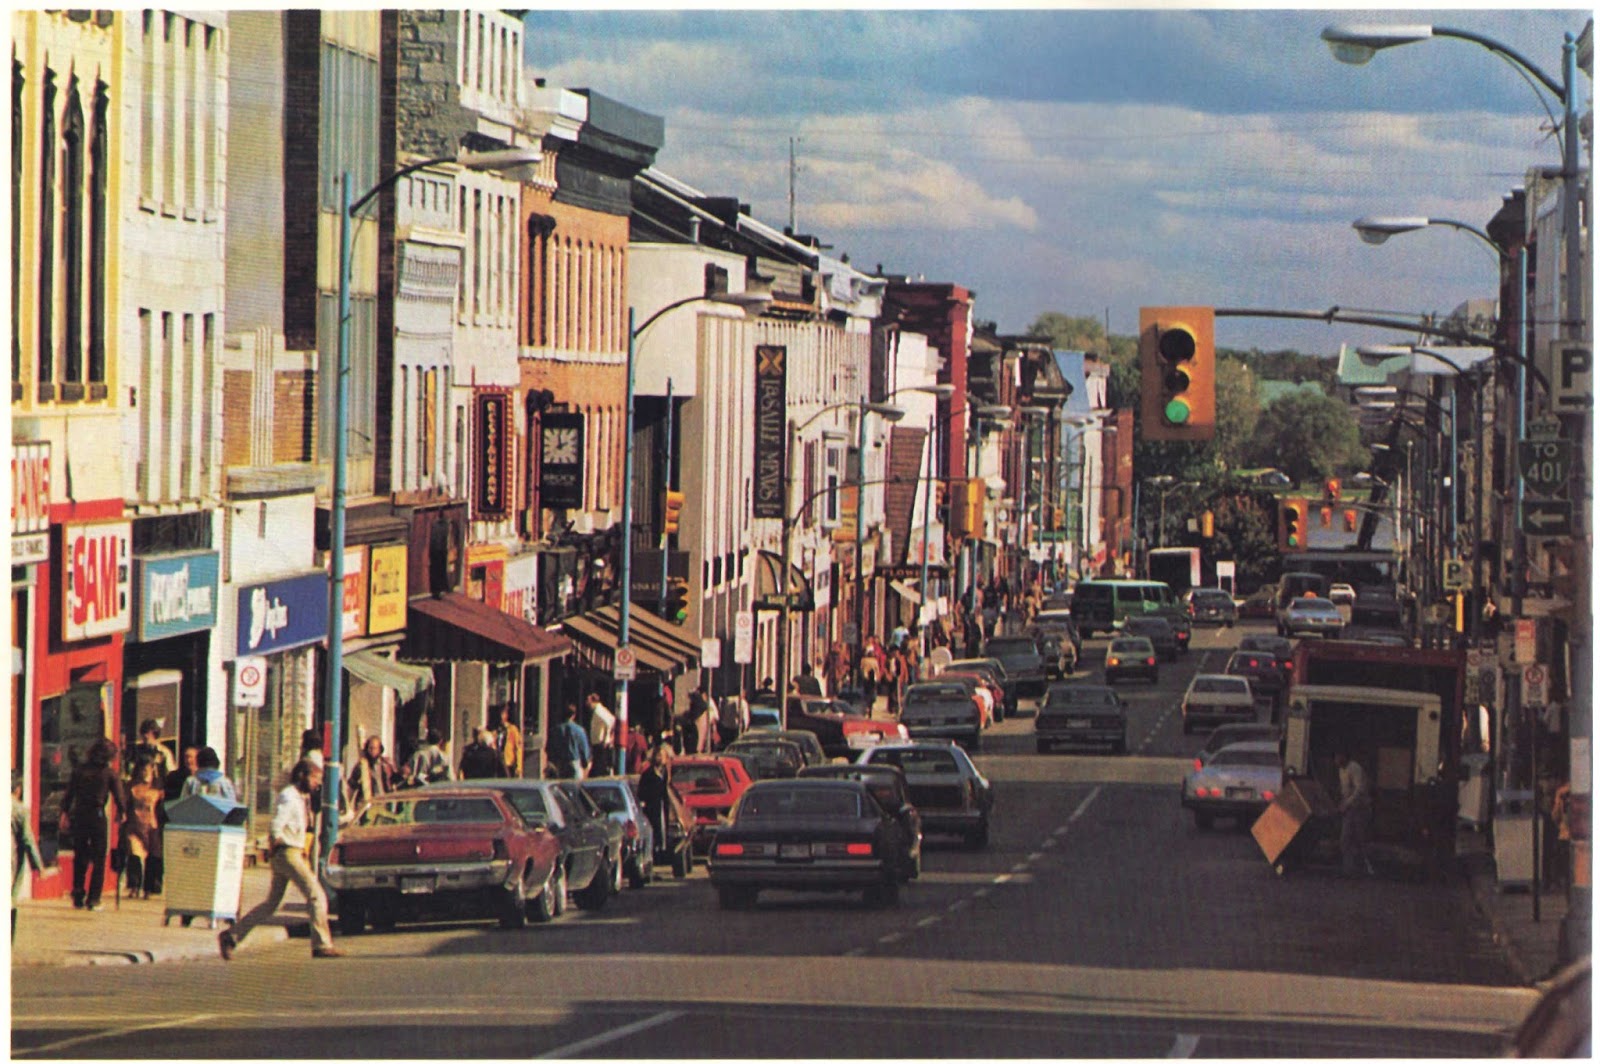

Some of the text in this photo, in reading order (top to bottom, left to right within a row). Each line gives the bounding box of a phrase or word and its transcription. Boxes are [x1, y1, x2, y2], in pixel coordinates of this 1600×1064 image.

[1562, 349, 1591, 389] P
[1532, 442, 1558, 458] TO
[1527, 462, 1562, 482] 401
[73, 535, 117, 626] SAM
